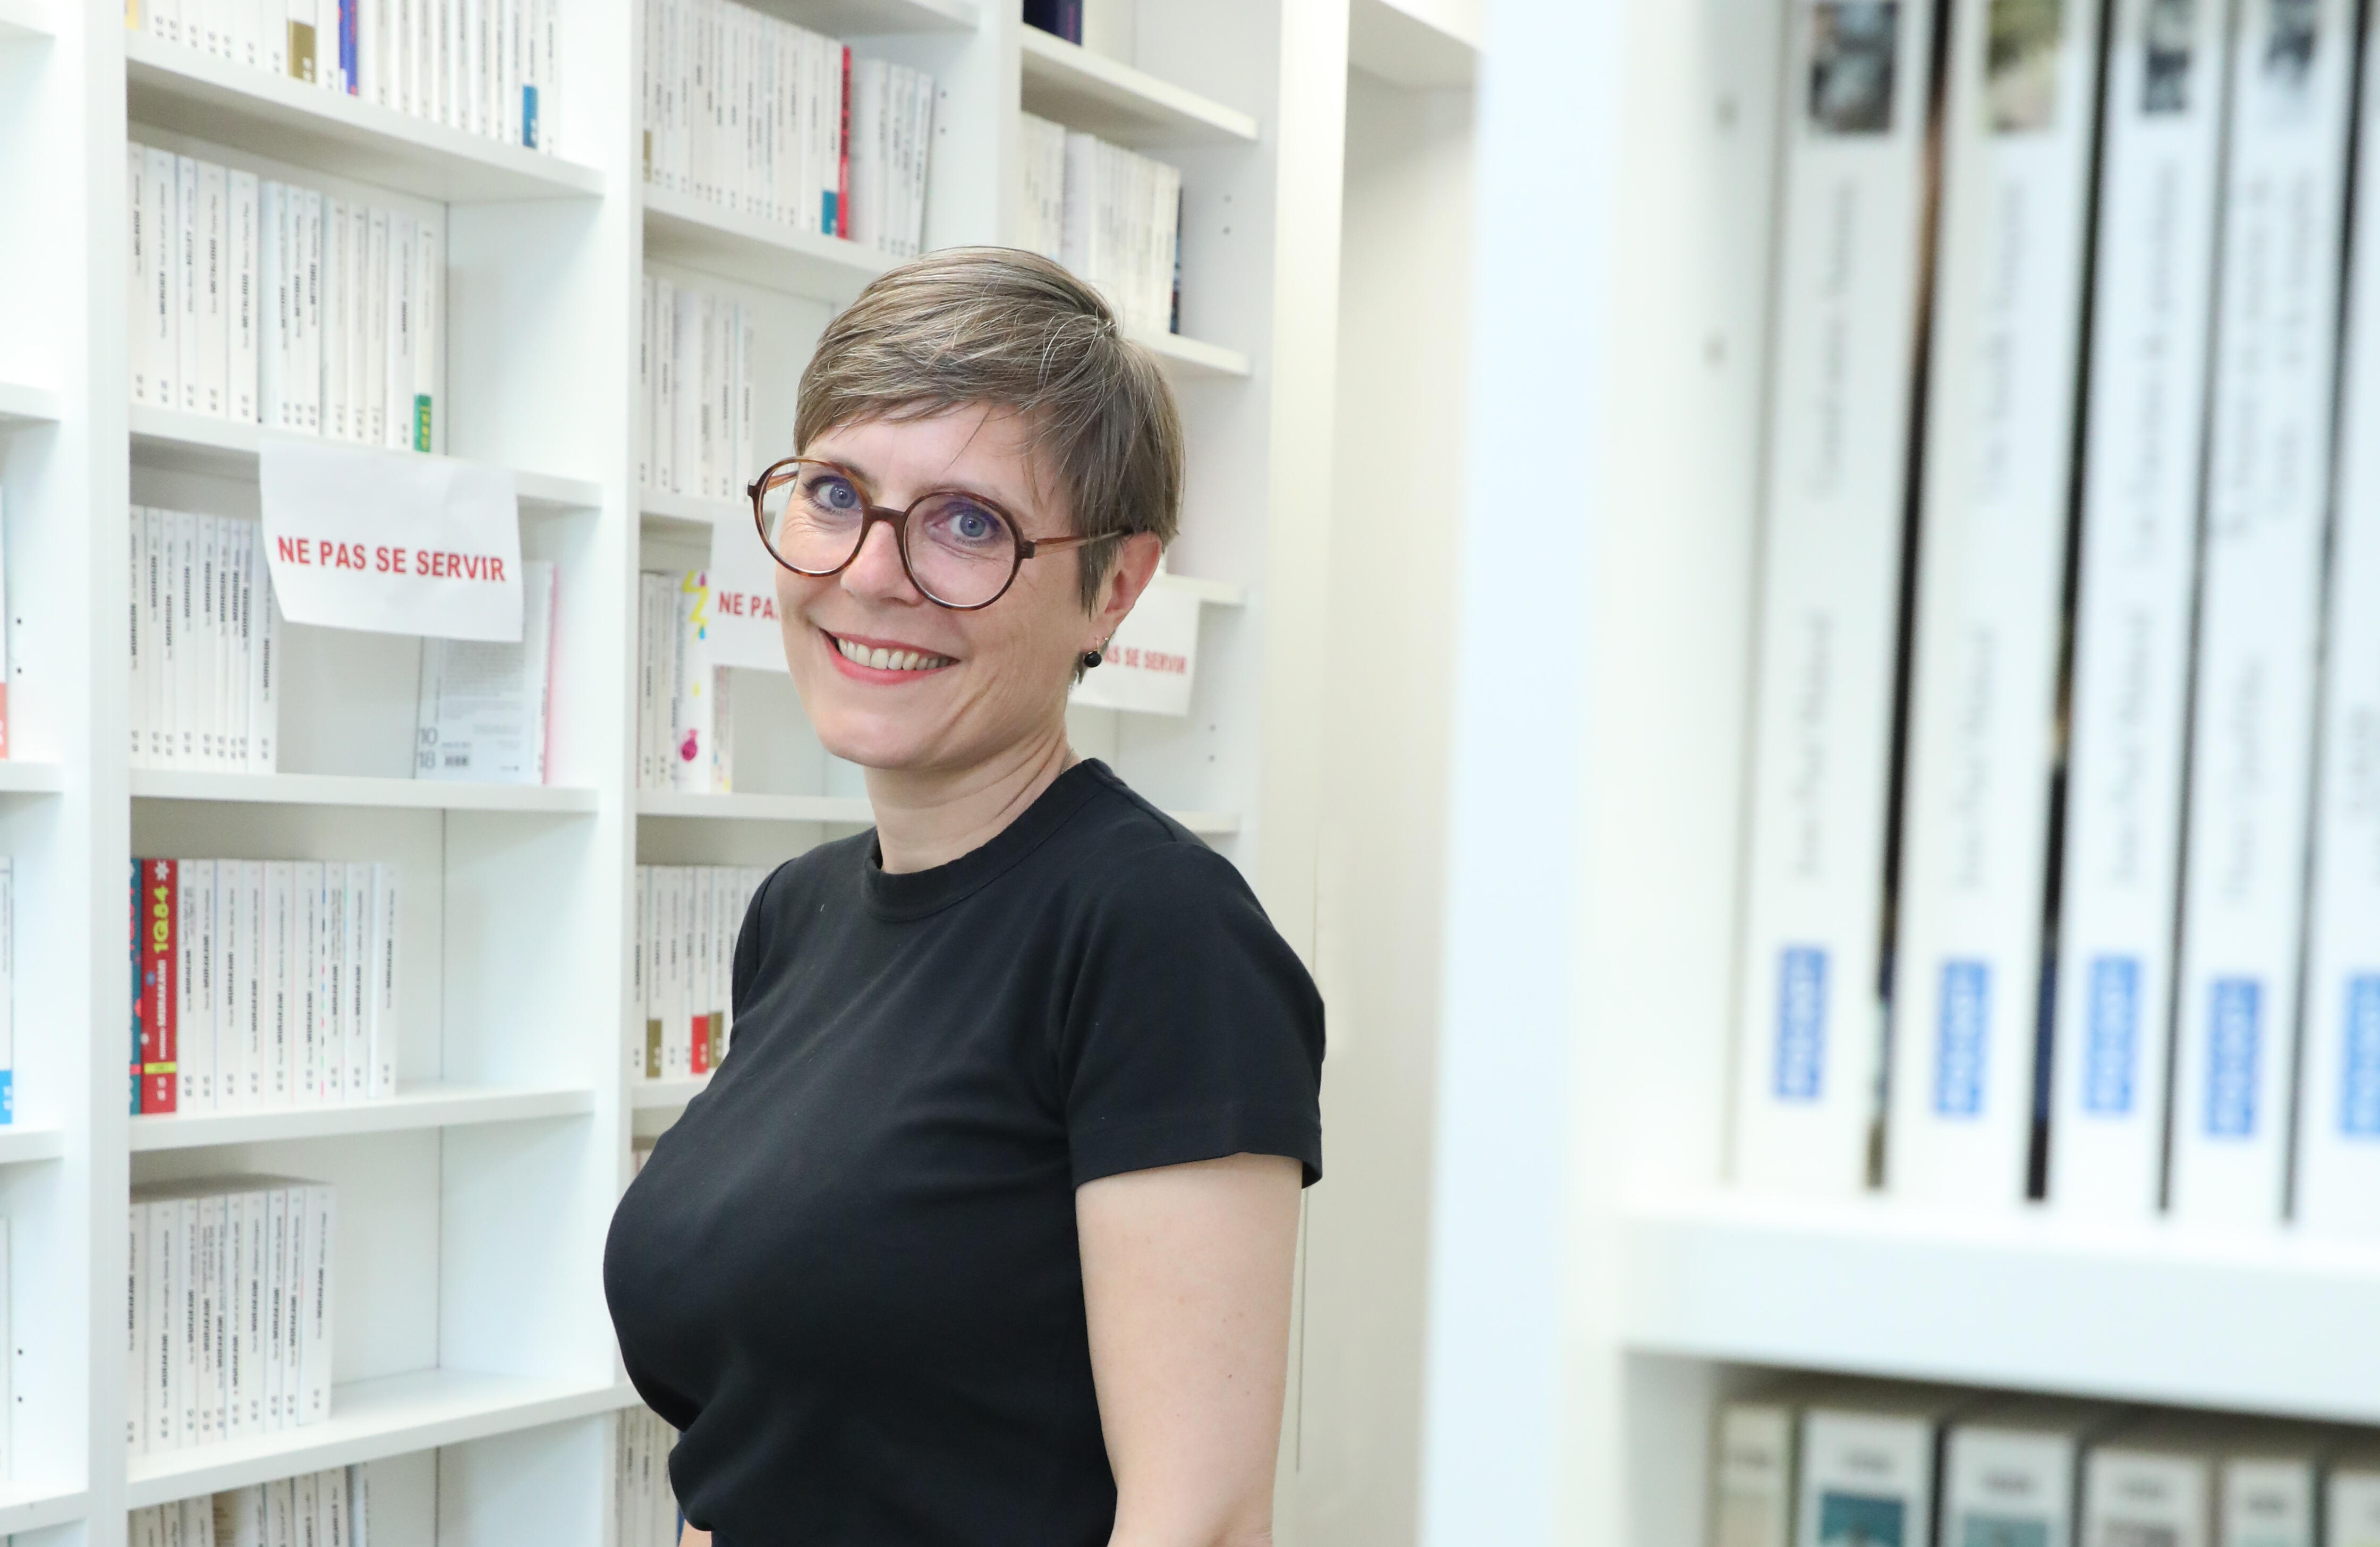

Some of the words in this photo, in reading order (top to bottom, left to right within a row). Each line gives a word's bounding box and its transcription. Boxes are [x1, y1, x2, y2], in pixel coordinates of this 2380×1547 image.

[277, 537, 311, 565] NE
[319, 541, 366, 571] PAS
[376, 547, 406, 574] SE
[416, 550, 505, 582] SERVIR
[718, 592, 743, 616] NE
[750, 596, 779, 620] PA
[153, 885, 169, 953] 1Q84
